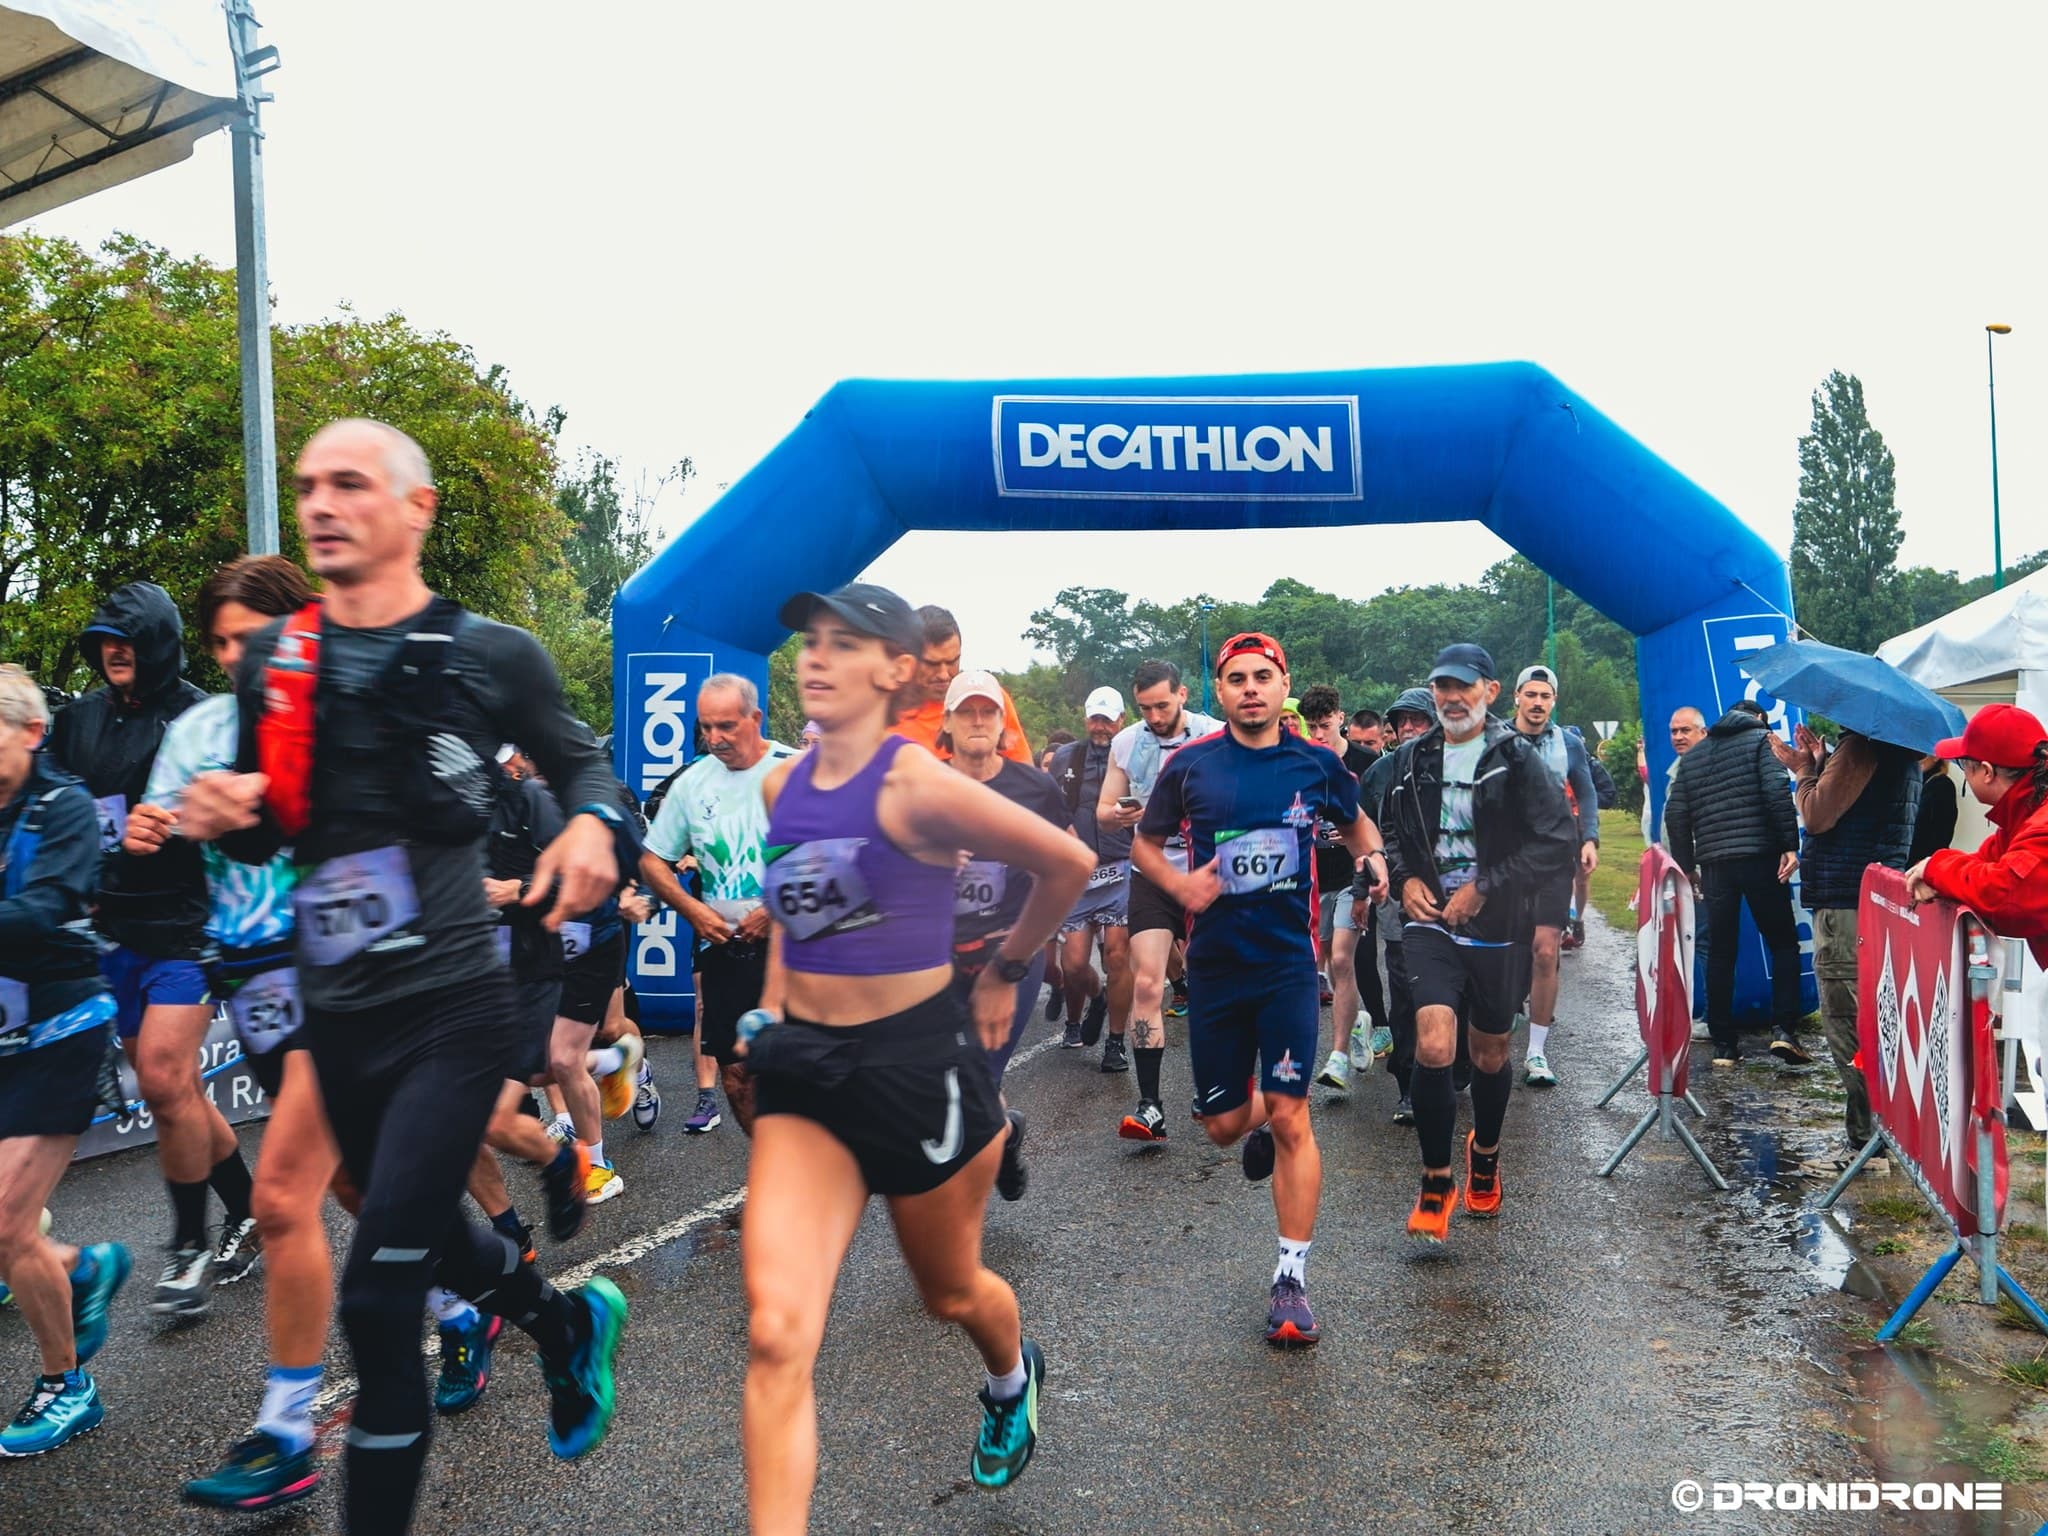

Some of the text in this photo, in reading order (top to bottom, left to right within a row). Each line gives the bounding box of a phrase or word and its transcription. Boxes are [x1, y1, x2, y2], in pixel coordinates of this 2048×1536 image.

[1018, 422, 1334, 473] DECATHLON
[637, 672, 687, 977] DELON
[1231, 853, 1286, 876] 667
[777, 877, 848, 916] 654
